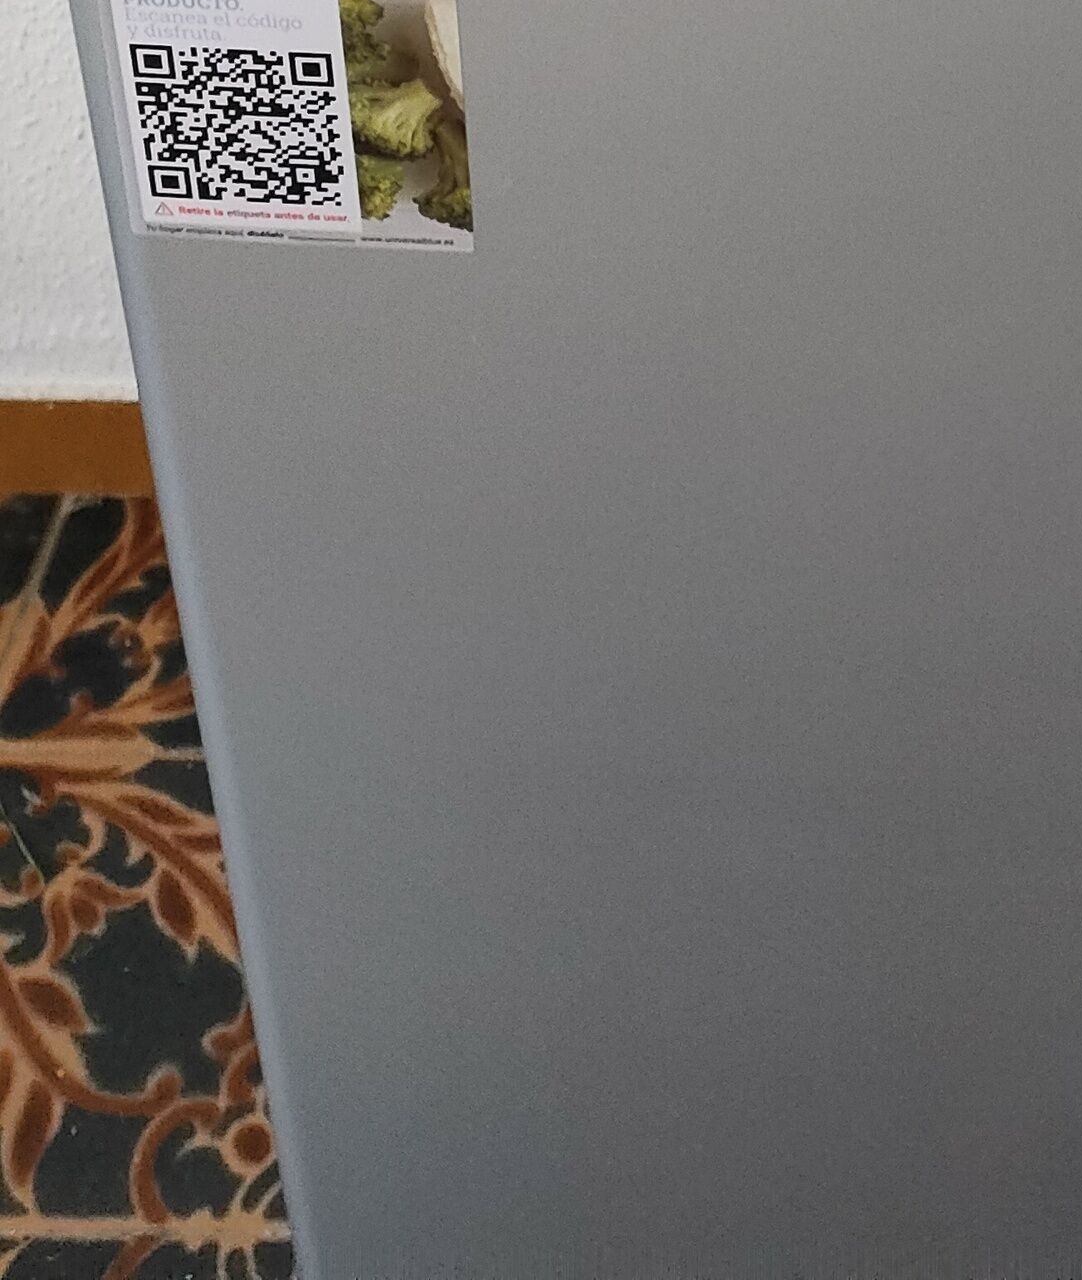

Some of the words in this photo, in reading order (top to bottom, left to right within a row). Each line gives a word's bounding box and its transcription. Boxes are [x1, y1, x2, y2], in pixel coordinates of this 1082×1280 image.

[124, 7, 208, 25] Escanea
[213, 11, 230, 27] el
[236, 14, 303, 33] código
[126, 24, 139, 41] y
[178, 206, 211, 216] Retire
[214, 208, 224, 217] la
[227, 209, 272, 220] etiqueta
[274, 211, 304, 221] antes
[307, 213, 321, 222] de
